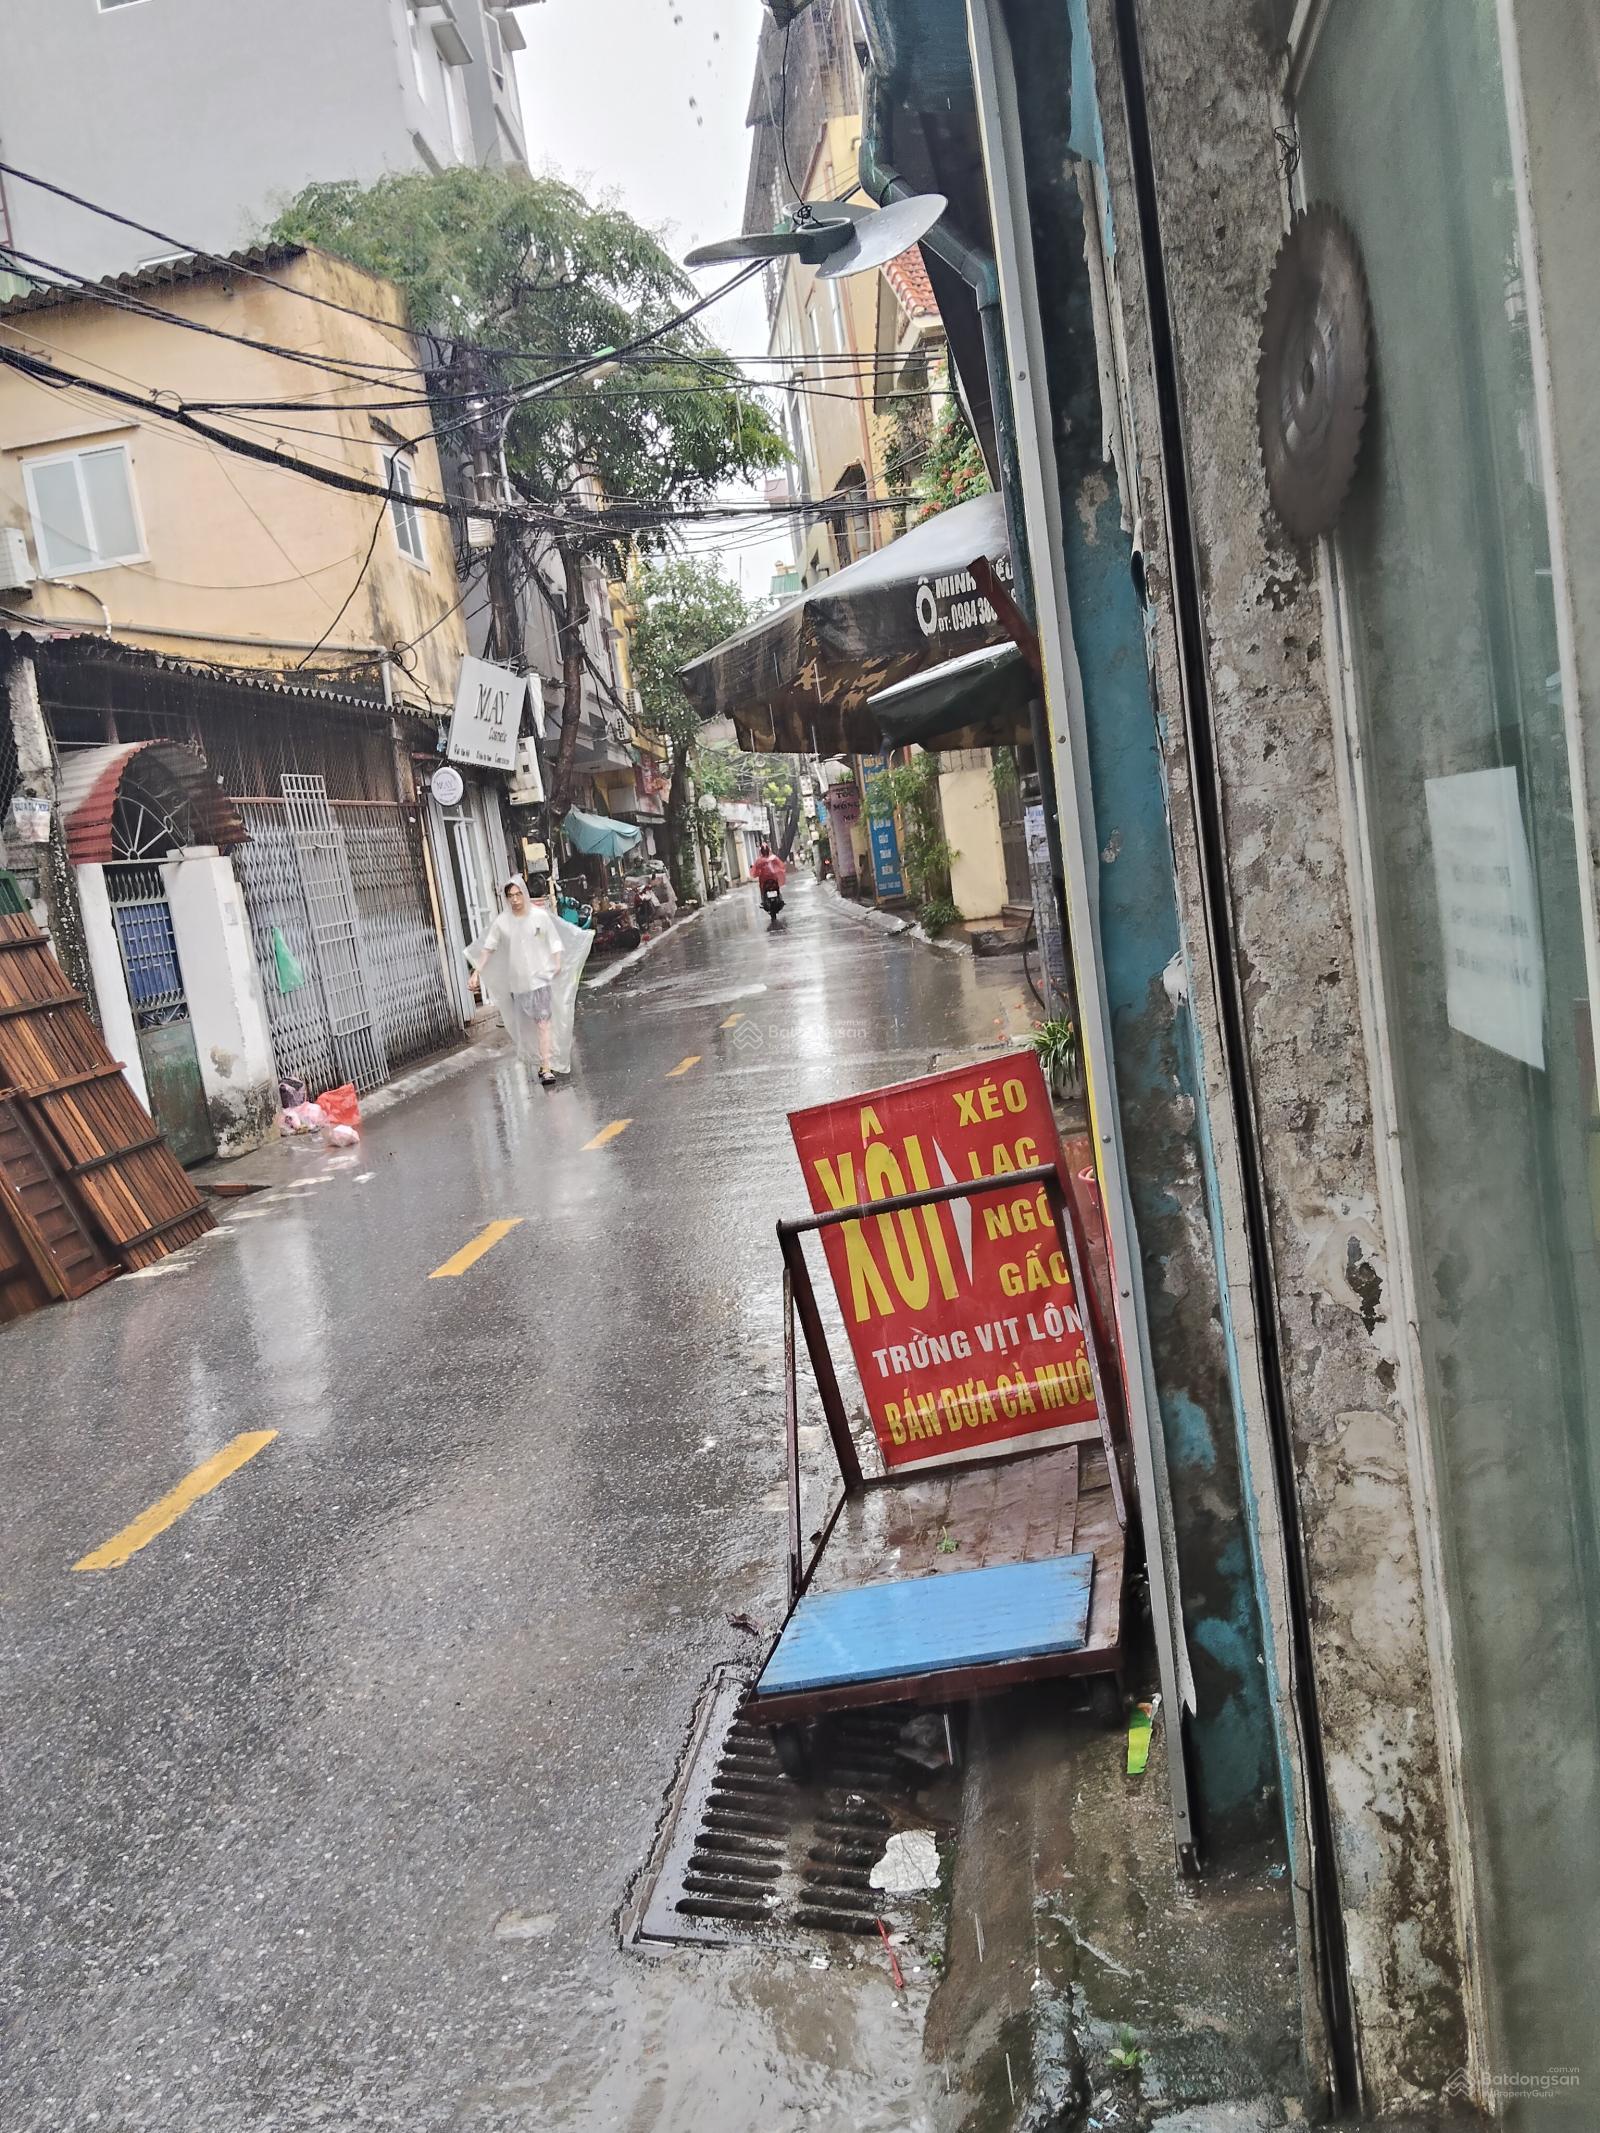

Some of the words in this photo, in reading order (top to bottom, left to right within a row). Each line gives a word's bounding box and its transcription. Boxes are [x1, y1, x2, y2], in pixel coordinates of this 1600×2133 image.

[916, 576, 937, 637] Ô
[951, 600, 977, 631] 0984
[952, 1077, 1028, 1127] XÉO
[814, 1105, 960, 1323] XÔI
[999, 1243, 1071, 1297] GẤC
[872, 1329, 972, 1378] TRỨNG
[974, 1316, 1020, 1356] VỊT
[1026, 1302, 1084, 1343] LỘN
[884, 1388, 943, 1446] BÁN
[996, 1361, 1037, 1419] CÀ
[1034, 1340, 1096, 1411] MUỐ
